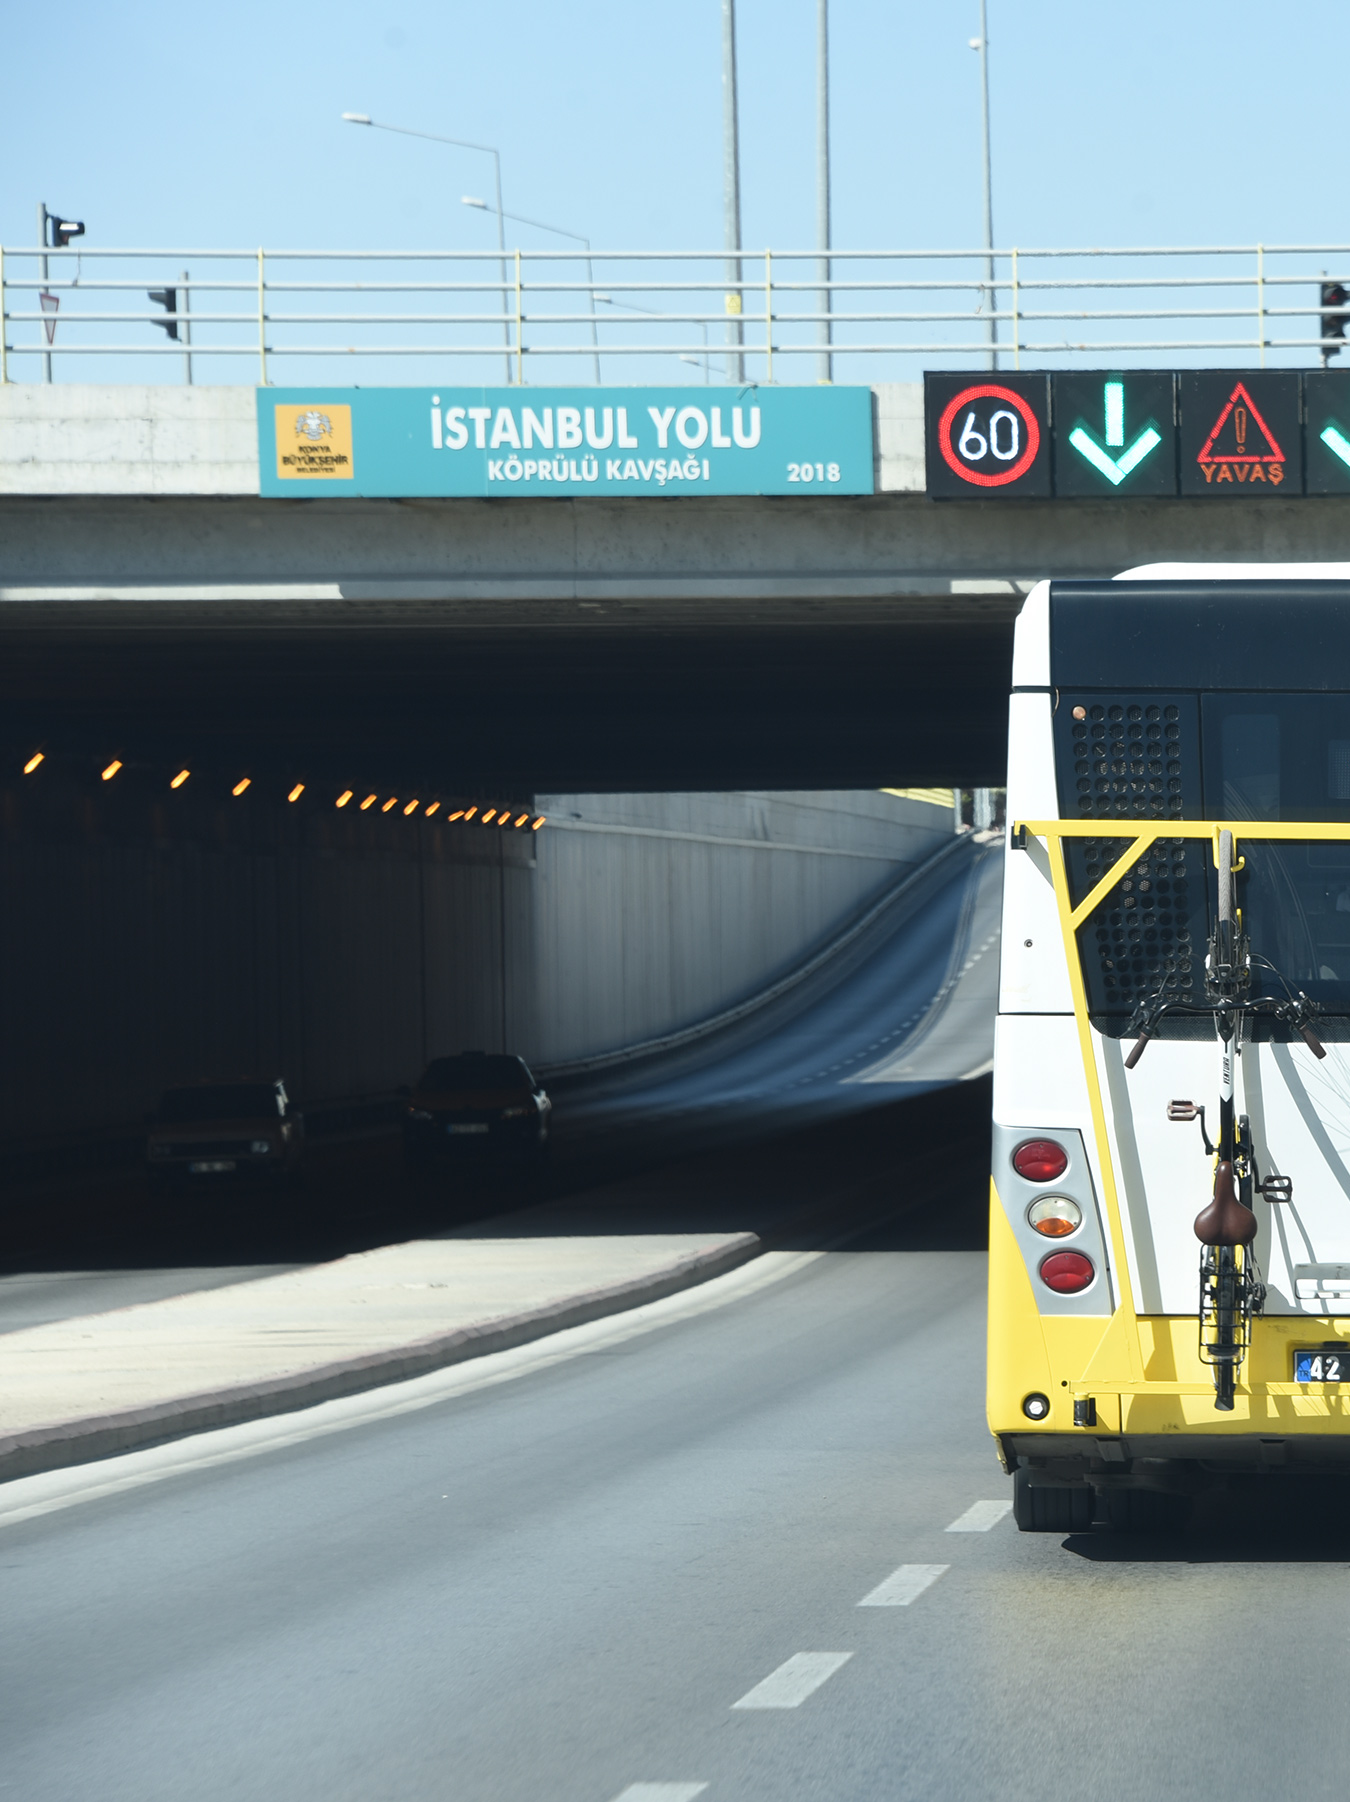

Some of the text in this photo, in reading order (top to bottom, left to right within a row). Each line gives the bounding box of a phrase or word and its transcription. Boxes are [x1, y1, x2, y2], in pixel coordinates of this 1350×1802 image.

[431, 395, 761, 450] İSTANBUL YOLU
[958, 410, 1019, 461] 60
[282, 454, 349, 467] BÜYÜKŞEHİR
[298, 445, 332, 453] KONYA
[488, 454, 709, 486] KÖPRÜLÜ KAVŞAĞI
[786, 462, 841, 483] 2018
[1200, 463, 1284, 486] YAVAŞ
[1222, 1056, 1230, 1085] VENTURA
[1310, 1355, 1341, 1381] 42
